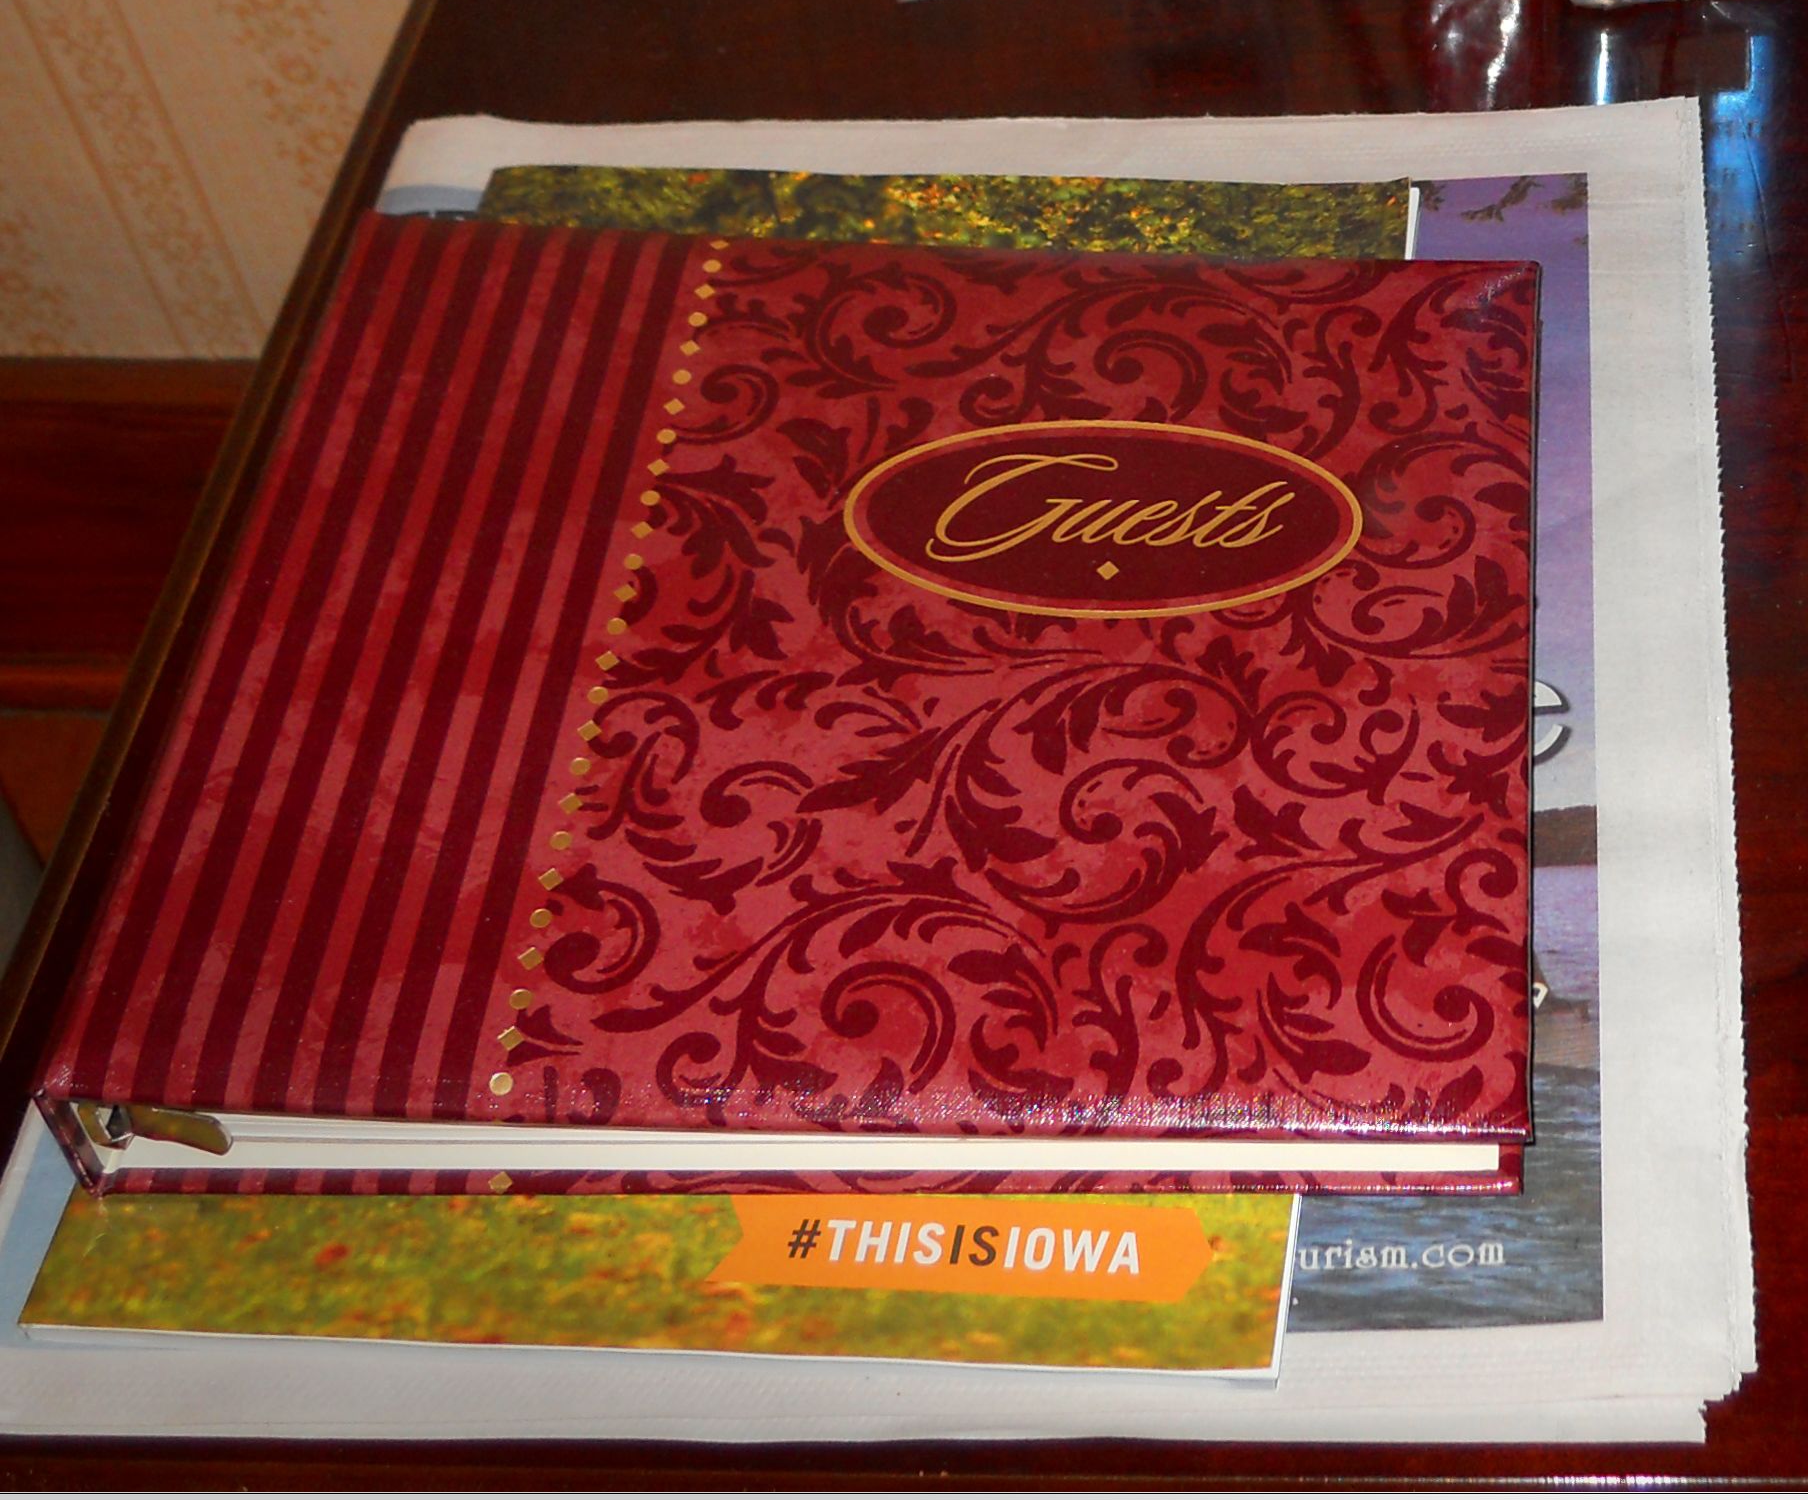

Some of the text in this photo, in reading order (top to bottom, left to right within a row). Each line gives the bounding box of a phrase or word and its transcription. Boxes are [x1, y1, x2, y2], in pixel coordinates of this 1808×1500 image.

[925, 453, 1296, 564] Guests
[787, 1217, 1144, 1277] #THISISIOWA
[1297, 1238, 1506, 1271] urism.com
